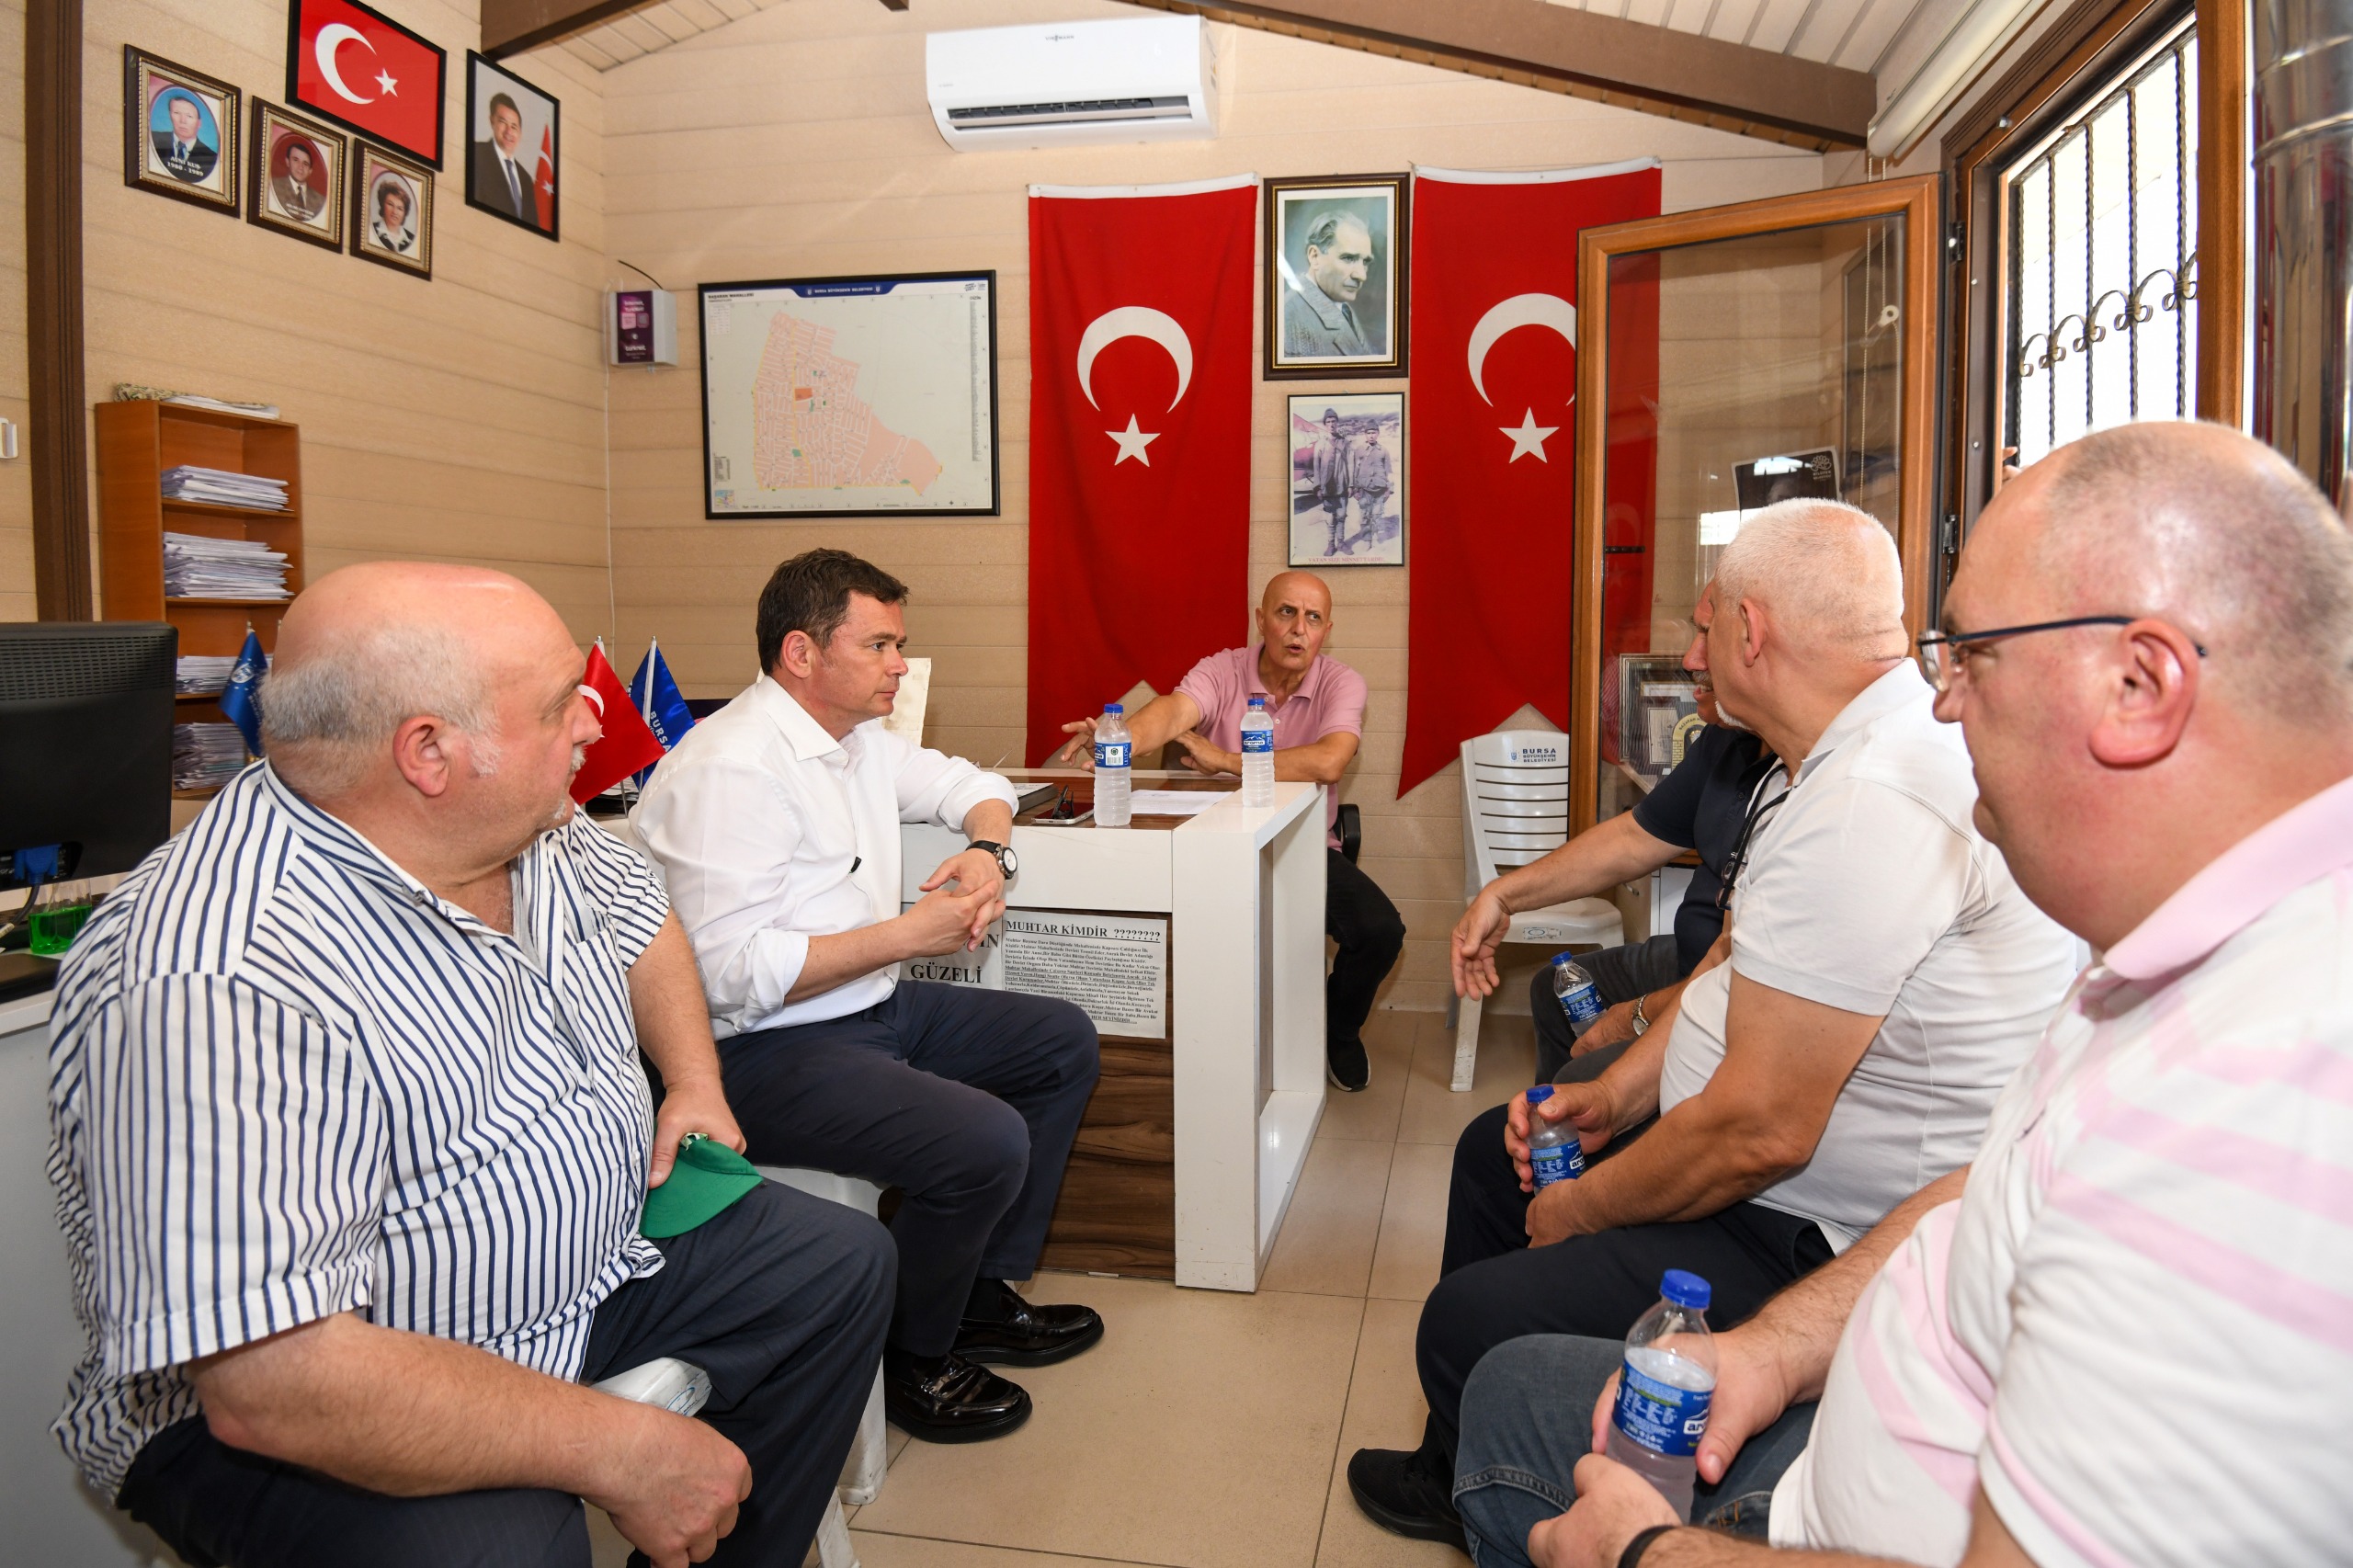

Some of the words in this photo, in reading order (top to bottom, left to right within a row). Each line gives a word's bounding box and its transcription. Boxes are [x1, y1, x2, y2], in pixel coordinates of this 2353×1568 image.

[650, 711, 671, 752] BURSA
[1006, 920, 1058, 933] MUHTAR
[1062, 924, 1108, 937] KİMDİR
[910, 961, 982, 983] GÜZELİ
[1572, 1158, 1584, 1167] aro
